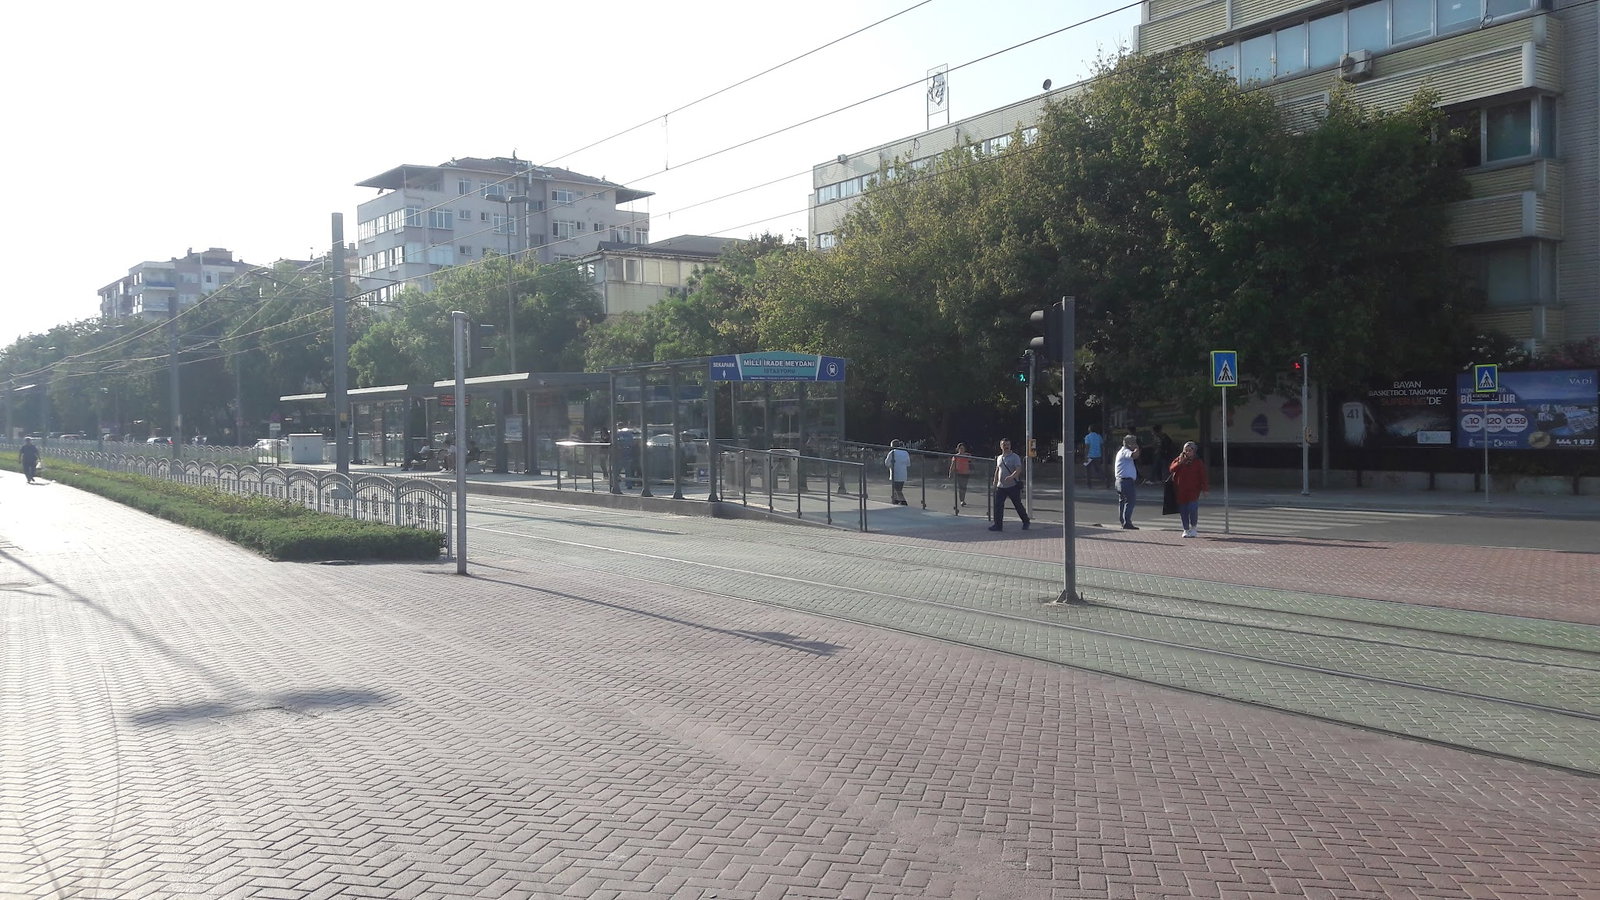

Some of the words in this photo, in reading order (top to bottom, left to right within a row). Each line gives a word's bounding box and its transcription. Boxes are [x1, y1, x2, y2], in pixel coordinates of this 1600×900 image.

[763, 359, 784, 367] İRADE
[1393, 381, 1421, 389] BAYAN
[1368, 389, 1408, 397] BASKETBOL
[1409, 388, 1448, 396] TAKIMIMIZ
[1505, 417, 1527, 425] 0.59
